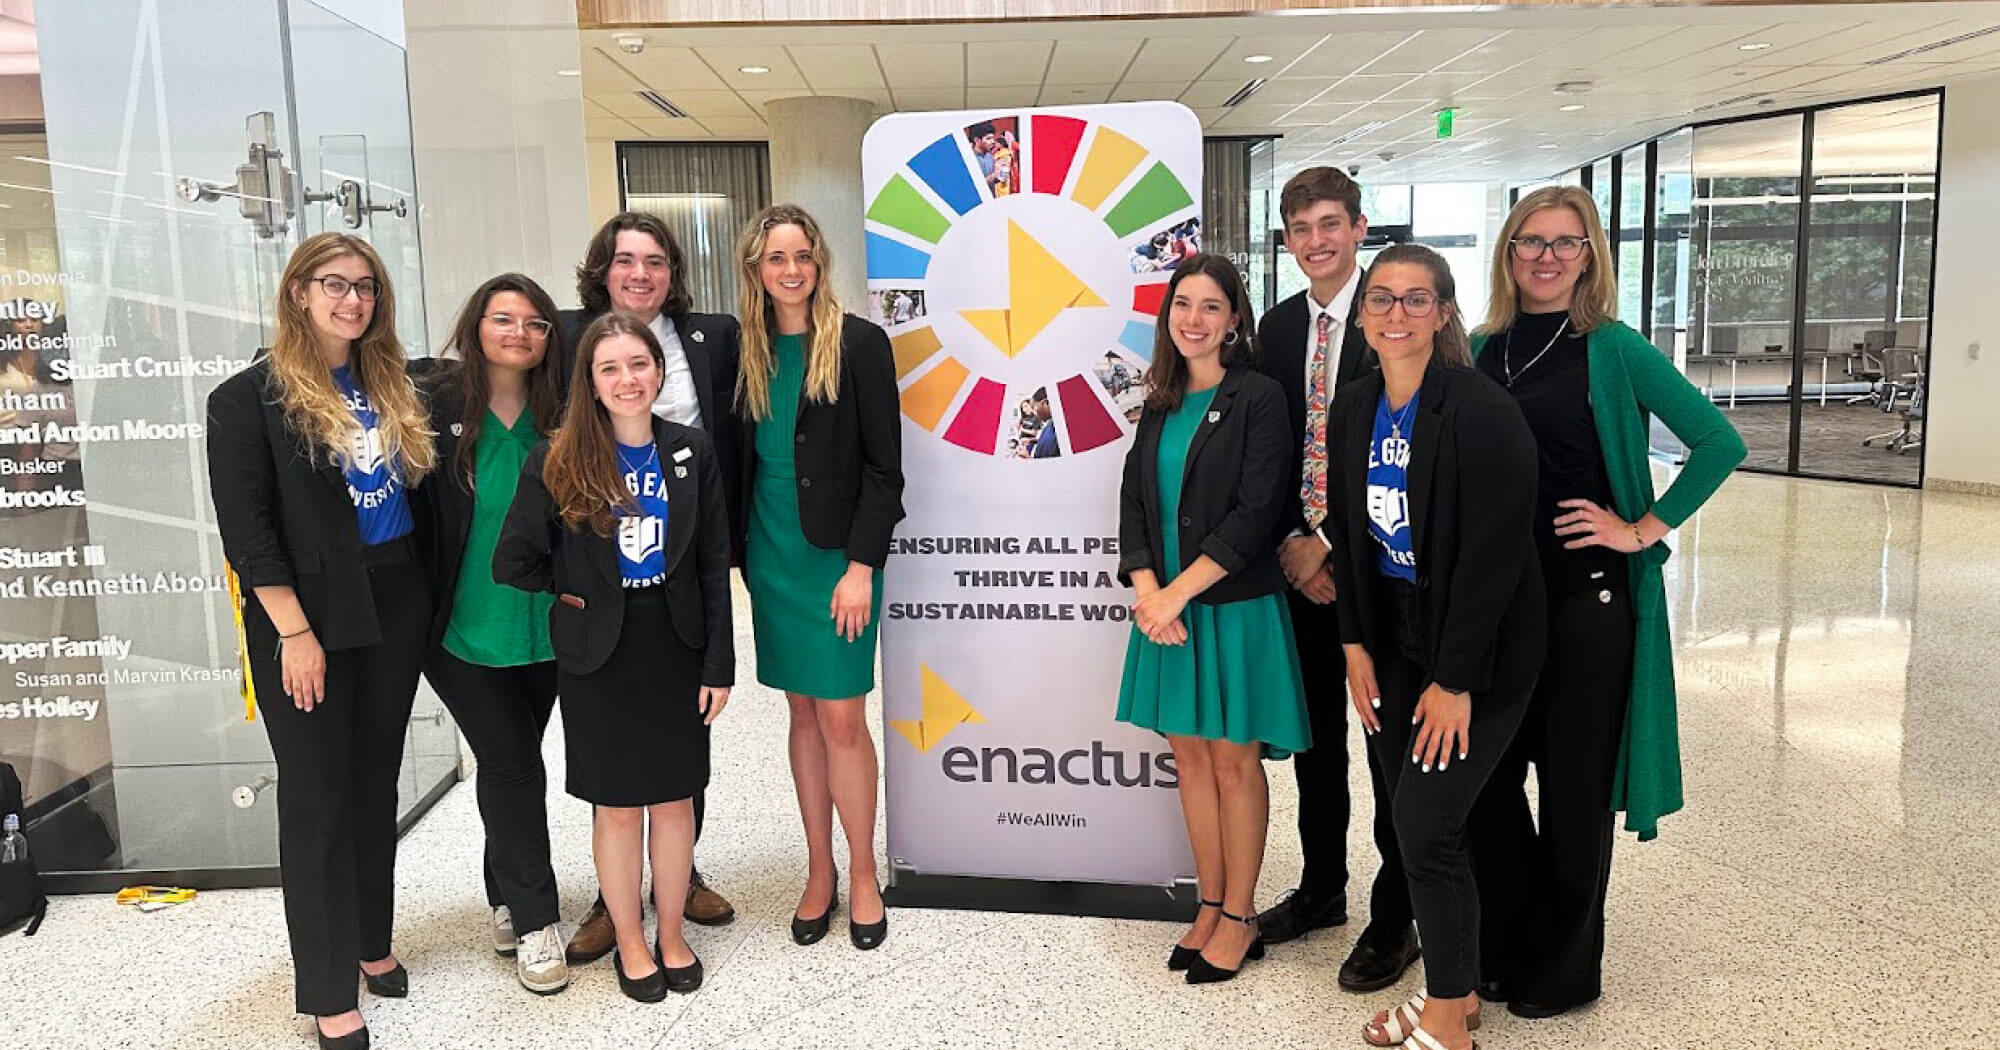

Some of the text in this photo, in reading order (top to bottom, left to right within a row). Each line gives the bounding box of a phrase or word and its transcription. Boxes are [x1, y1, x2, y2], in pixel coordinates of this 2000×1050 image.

[26, 332, 117, 350] Gachman
[50, 353, 253, 381] Stuart Cruiksha
[44, 420, 119, 443] Ardon
[123, 419, 203, 440] Moore
[1, 457, 65, 475] Busker
[0, 545, 105, 569] Stuart III
[888, 537, 1020, 555] ENSURING
[1026, 537, 1077, 555] ALL
[33, 571, 148, 598] Kenneth
[954, 571, 1113, 588] THRIVE IN A
[888, 603, 1074, 621] SUSTAINABLE
[51, 635, 132, 660] Family
[15, 671, 72, 687] Susan
[75, 669, 109, 685] and
[113, 666, 176, 684] Marvin
[22, 695, 100, 721] Holley
[941, 740, 1180, 789] enactus
[996, 812, 1087, 828] #WeAllWin
